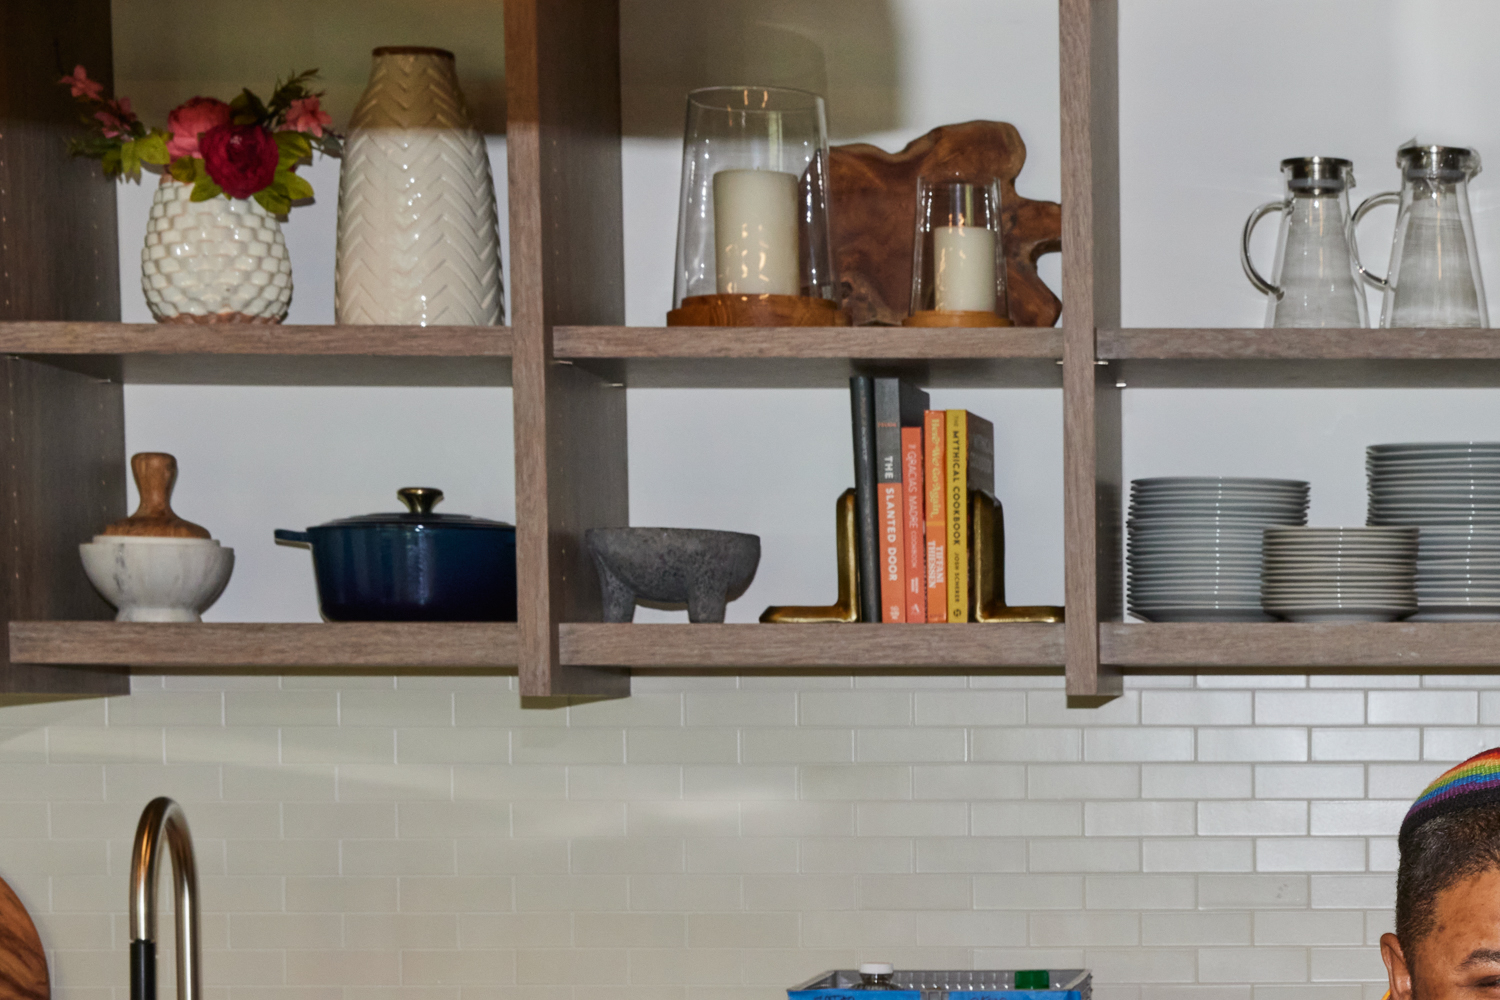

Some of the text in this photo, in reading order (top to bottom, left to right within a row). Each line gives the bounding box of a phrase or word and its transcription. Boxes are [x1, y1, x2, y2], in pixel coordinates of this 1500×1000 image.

[907, 451, 917, 493] GRACIAS
[931, 468, 940, 482] Go
[952, 430, 960, 482] MYTHICAL
[884, 456, 898, 581] THE SLANTED DOOR
[909, 495, 919, 528] MADRE
[952, 486, 961, 545] COOKBOOK
[927, 540, 936, 588] THIESSEN
[936, 545, 944, 583] TIFFANI
